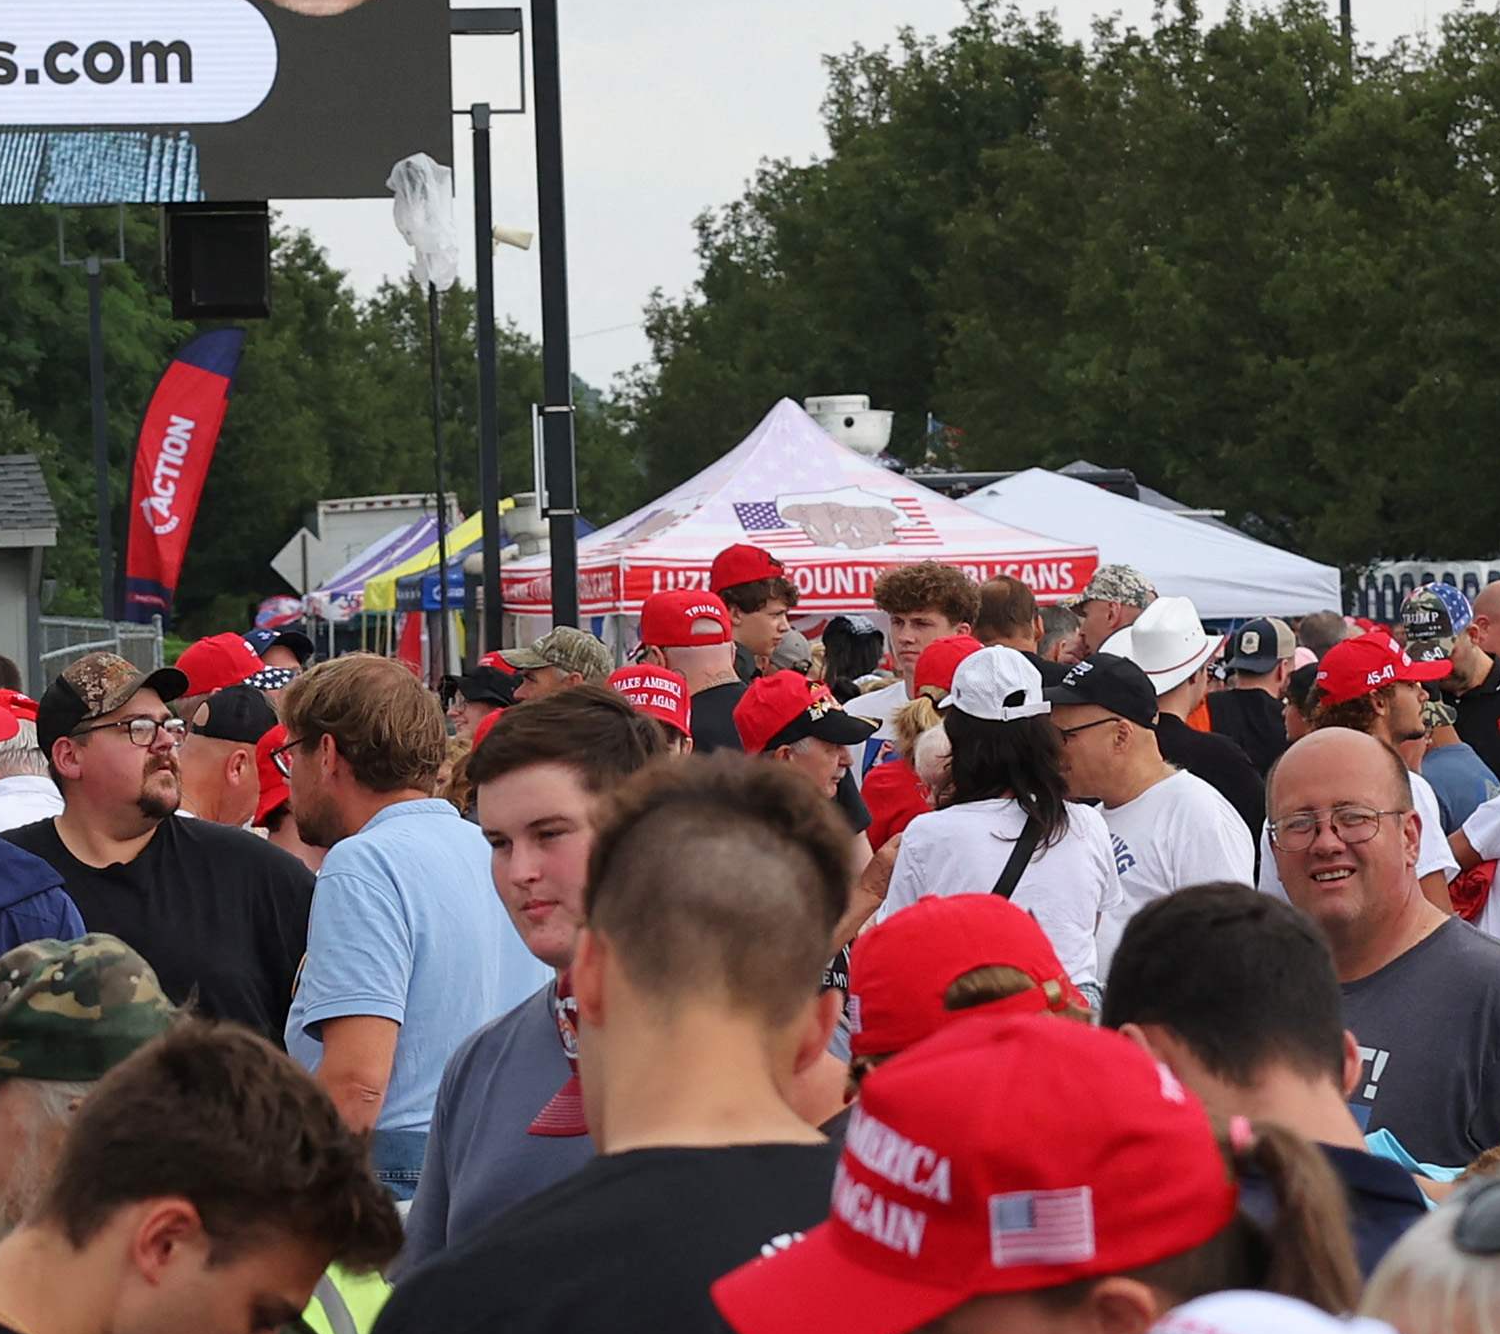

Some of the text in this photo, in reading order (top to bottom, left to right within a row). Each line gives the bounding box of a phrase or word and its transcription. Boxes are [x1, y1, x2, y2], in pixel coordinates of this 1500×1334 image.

[148, 414, 196, 517] ACTION
[684, 604, 722, 618] TRUMP
[1402, 611, 1440, 625] TRUMP
[1366, 664, 1395, 686] 45-47
[613, 676, 681, 699] MAKE AMERICA
[650, 693, 677, 712] AGAIN
